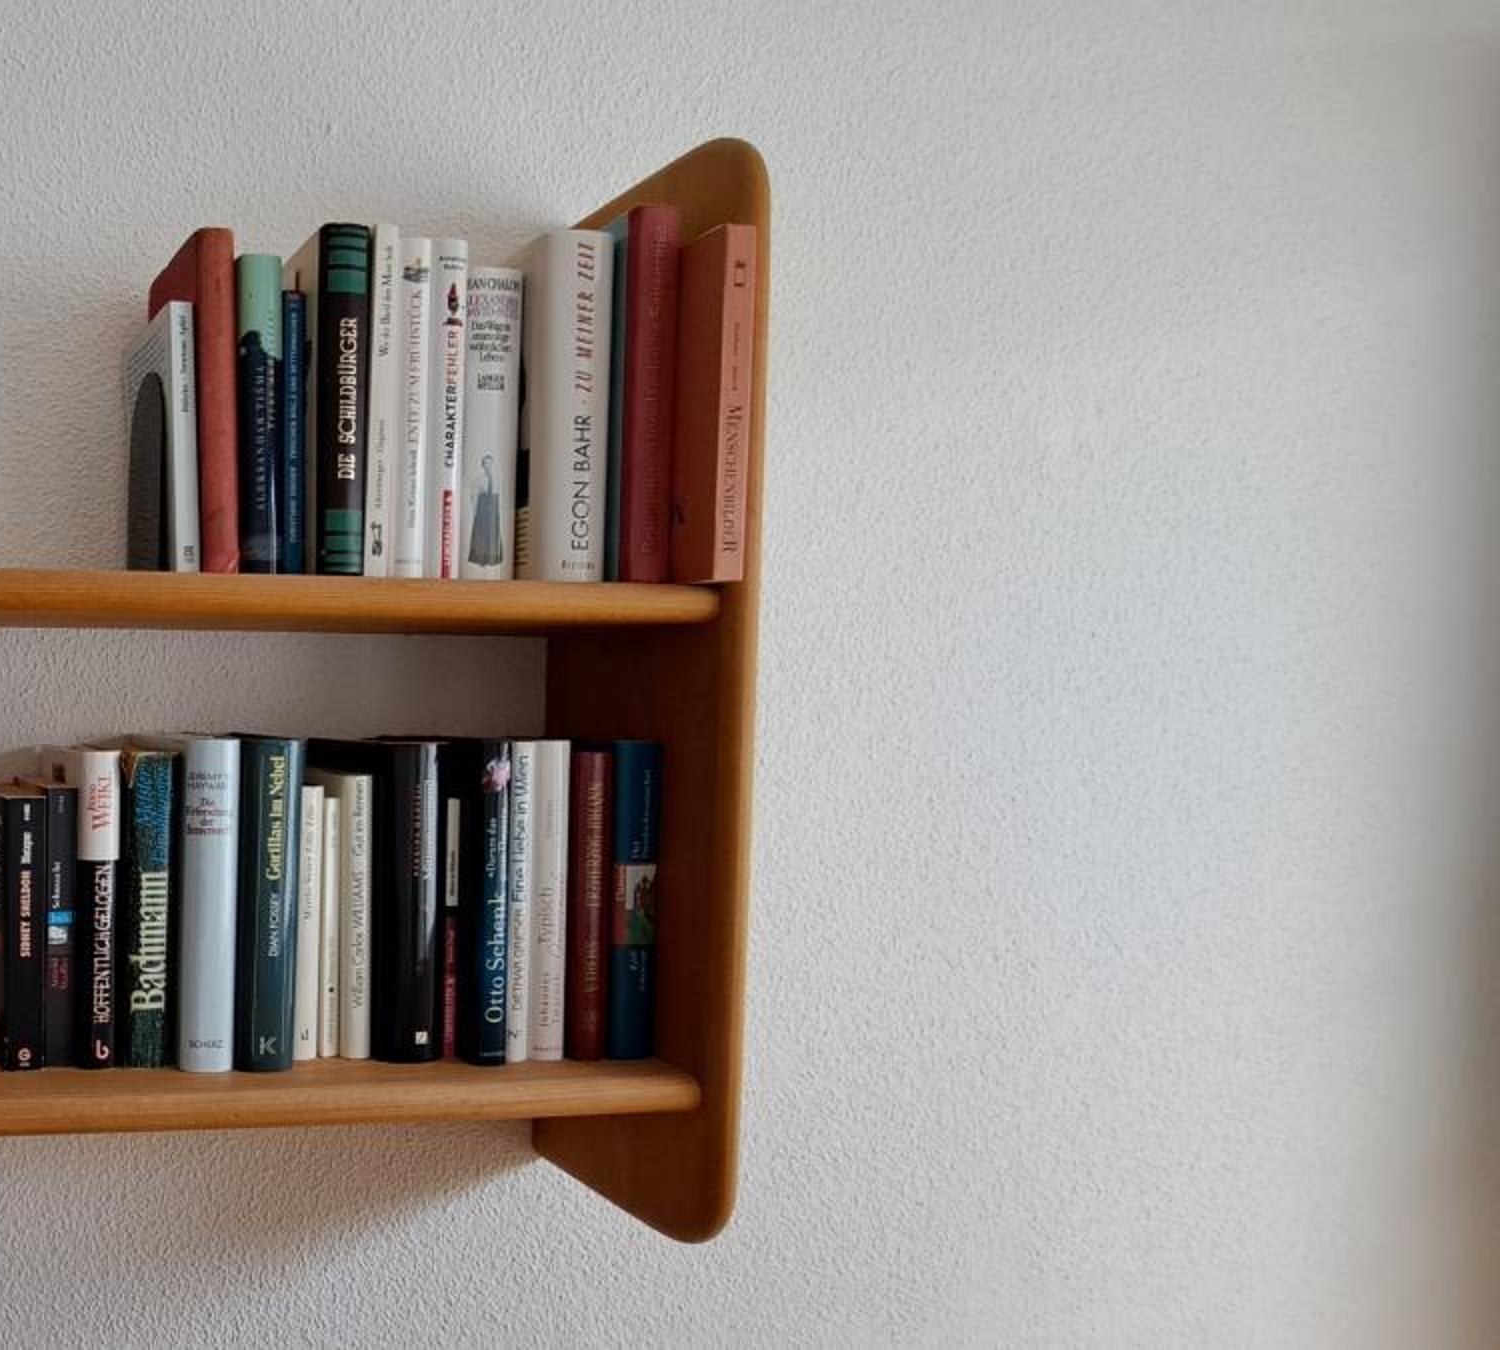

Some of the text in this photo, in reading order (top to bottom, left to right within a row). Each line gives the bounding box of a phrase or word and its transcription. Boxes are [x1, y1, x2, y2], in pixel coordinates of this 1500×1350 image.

[574, 241, 596, 393] ZU MEINER ZEIT
[337, 317, 359, 480] DIE SCHILDBÜRGER
[443, 331, 460, 468] CHARAKTERFEHLER
[570, 415, 592, 552] EGON BAHR
[722, 404, 743, 553] MENSCHENBILDER
[514, 755, 531, 798] Wien
[265, 755, 286, 881] Gorillas im Nebel
[513, 800, 528, 816] in
[512, 817, 527, 865] Liebe
[19, 870, 33, 918] SHELDON
[351, 871, 364, 930] WILLIAMS
[511, 866, 526, 905] Eine
[19, 920, 33, 959] SIDNEY
[92, 863, 112, 1024] HOFFENTLICH GELOGEN
[128, 870, 169, 1014] Bachmann
[267, 928, 279, 957] DIAN
[484, 892, 506, 1024] Otto Schenk
[350, 966, 364, 1009] William
[259, 1036, 277, 1055] K
